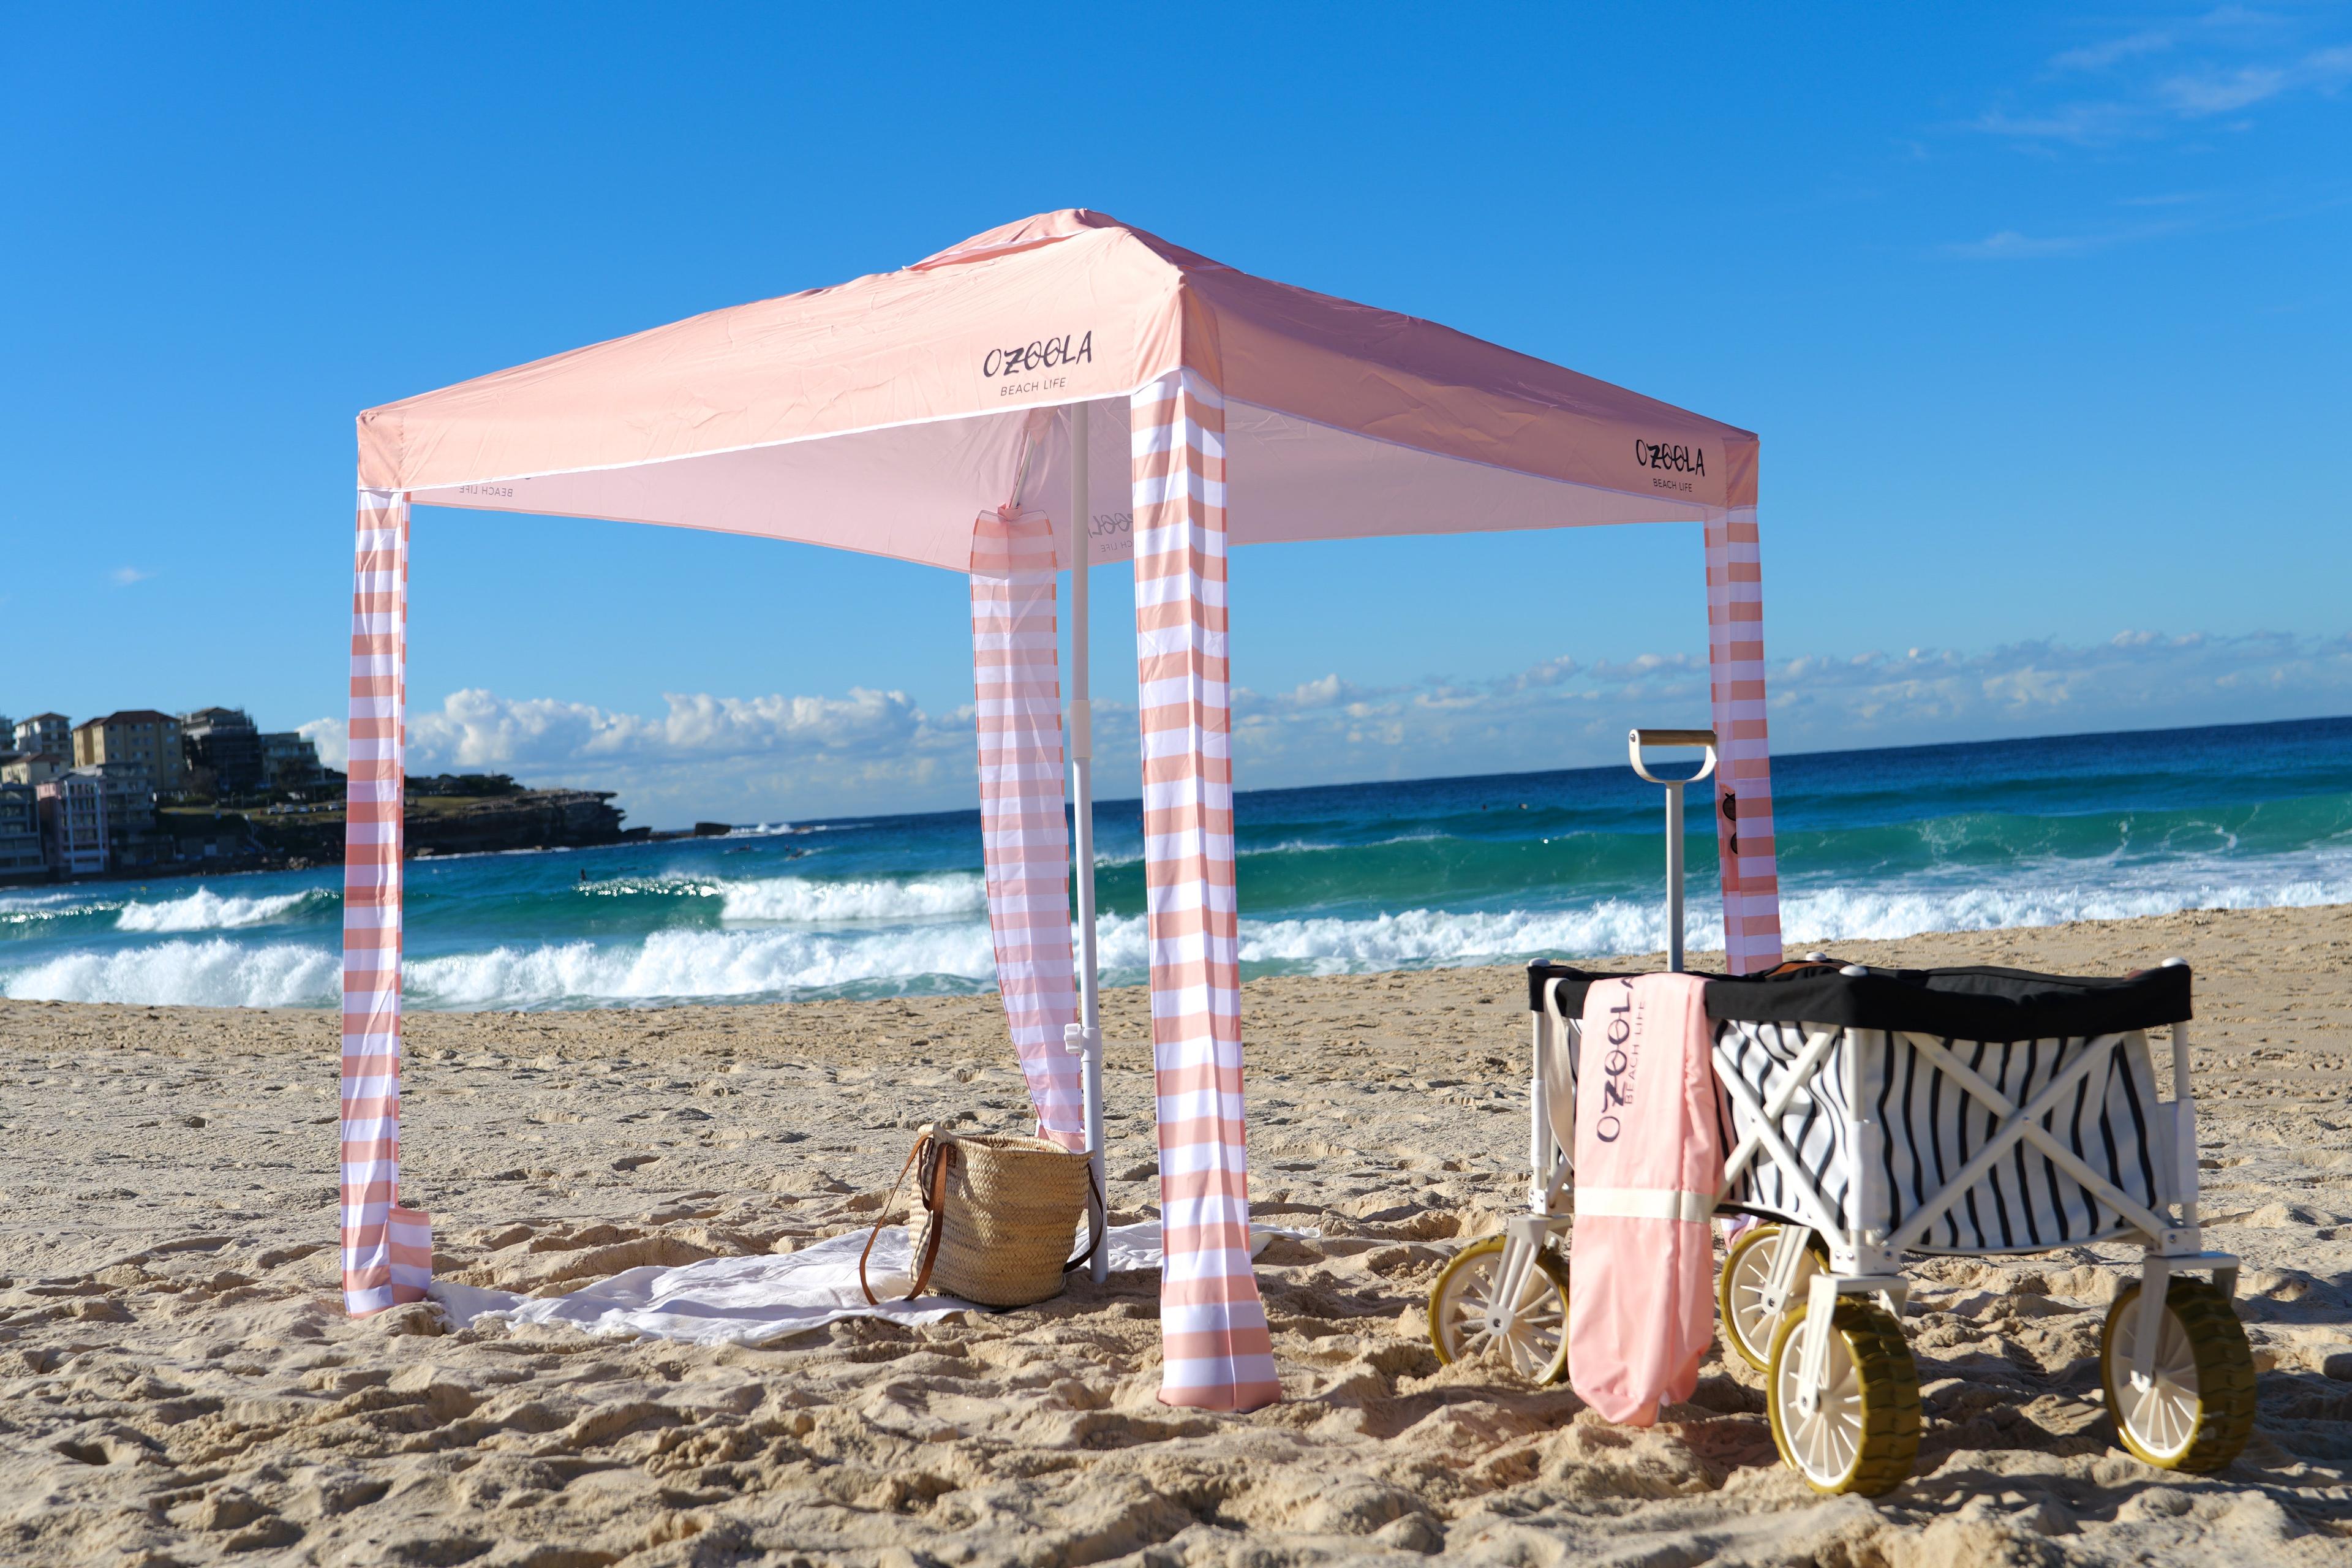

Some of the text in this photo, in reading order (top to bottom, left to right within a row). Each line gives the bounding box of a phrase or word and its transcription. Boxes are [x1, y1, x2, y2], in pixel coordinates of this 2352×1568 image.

[983, 330, 1092, 378] OZOOLA
[1000, 377, 1066, 396] BEACH LIFE
[1635, 439, 1705, 477] OZOOLA
[1653, 478, 1693, 492] BEACH LIFE
[1624, 1044, 1640, 1104] BEACH
